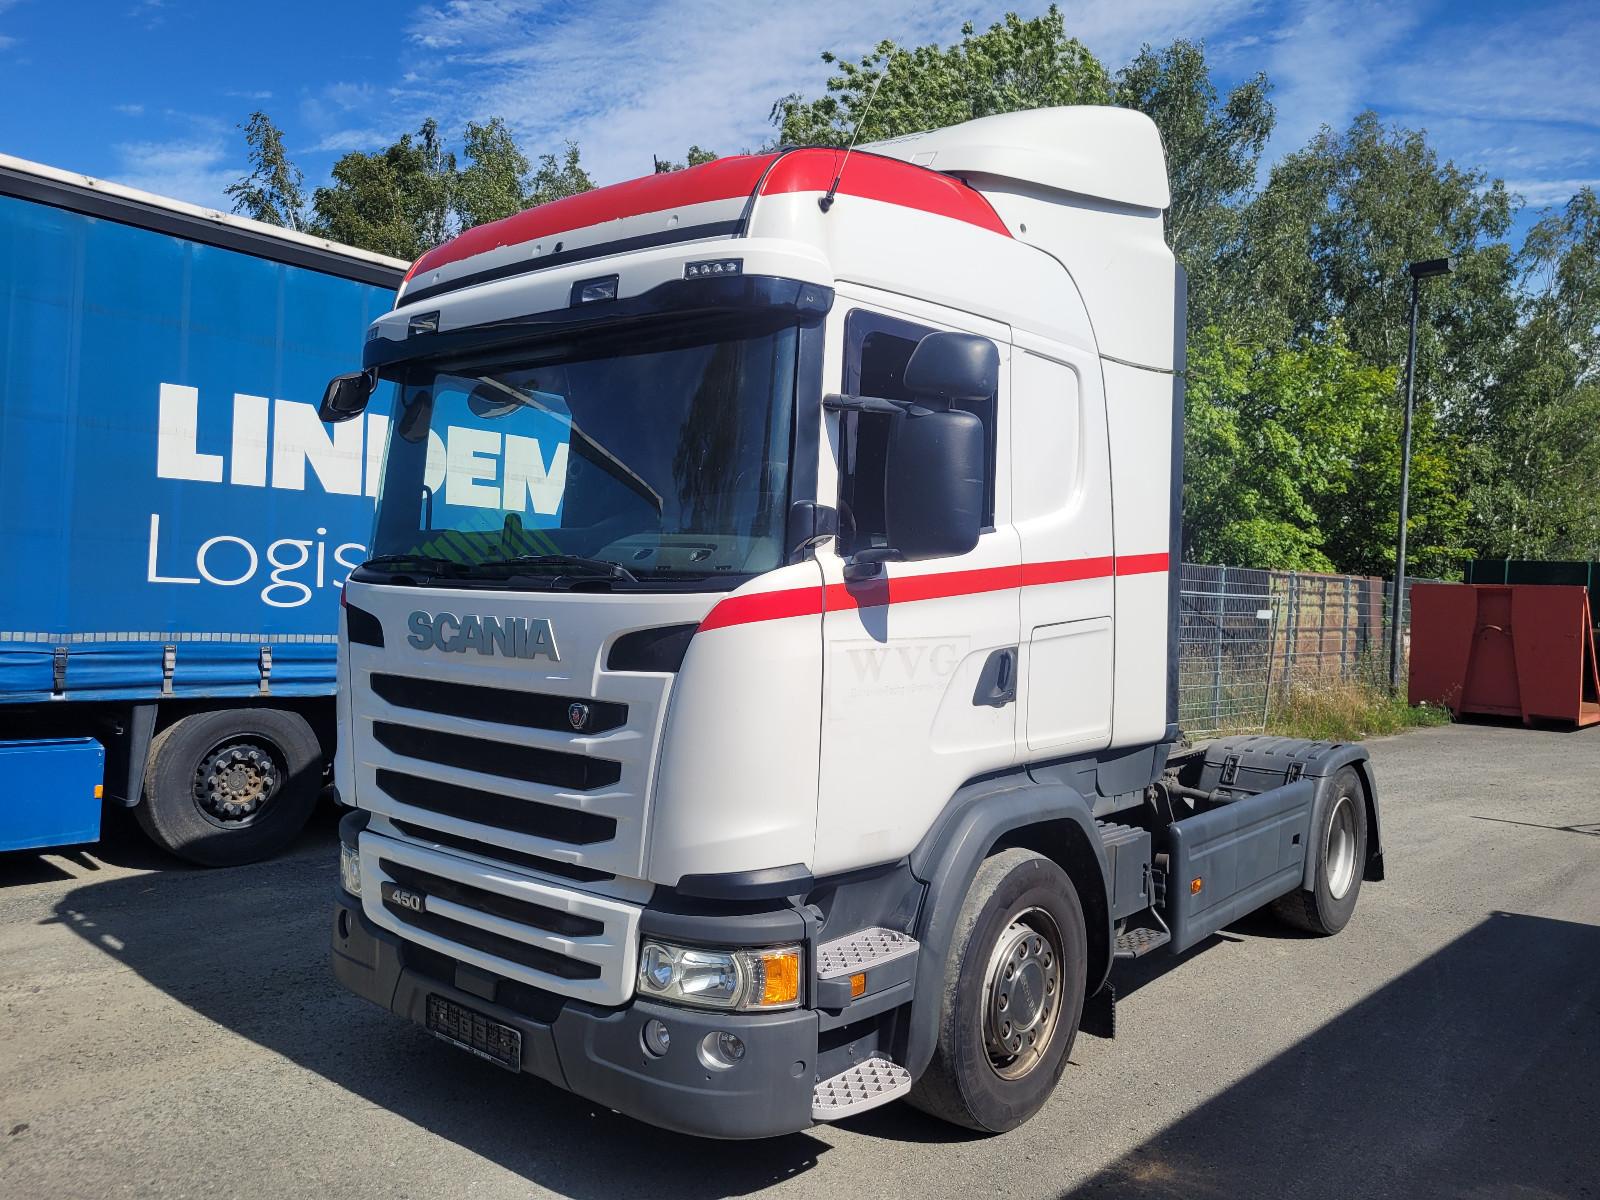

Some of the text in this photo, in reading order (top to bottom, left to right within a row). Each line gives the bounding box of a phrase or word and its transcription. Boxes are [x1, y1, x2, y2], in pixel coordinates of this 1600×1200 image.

[407, 610, 561, 661] SCANIA
[845, 643, 959, 682] WVG
[391, 884, 420, 911] 450
